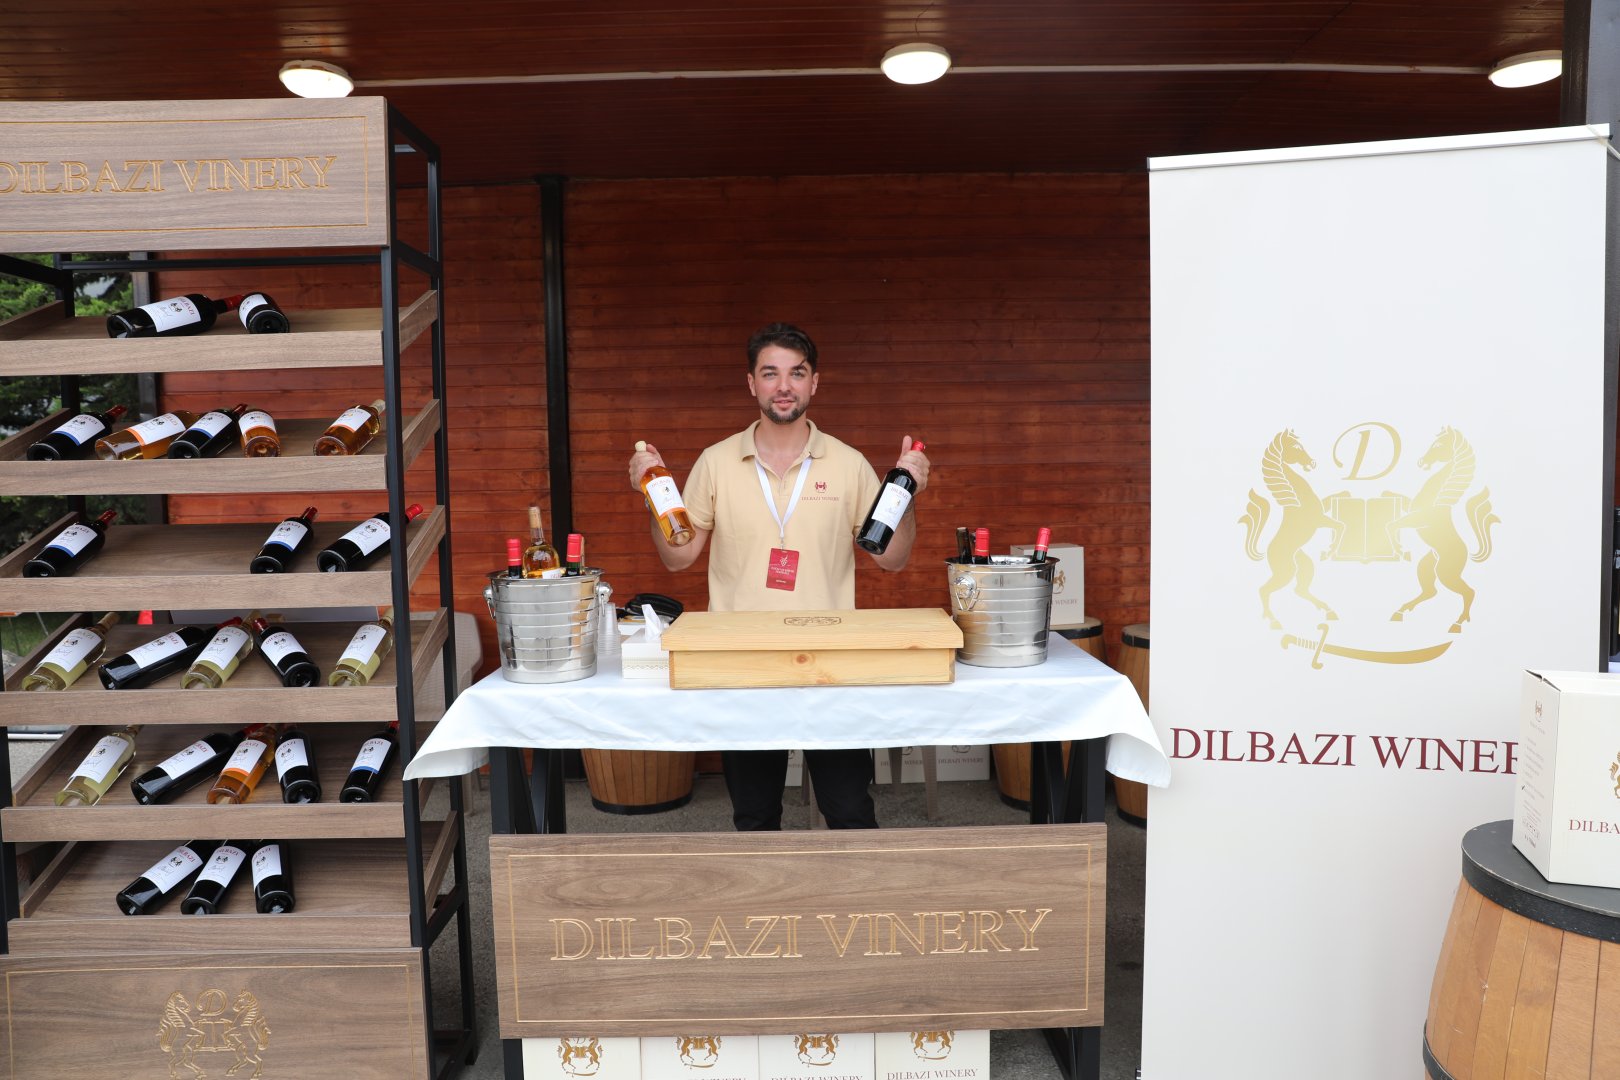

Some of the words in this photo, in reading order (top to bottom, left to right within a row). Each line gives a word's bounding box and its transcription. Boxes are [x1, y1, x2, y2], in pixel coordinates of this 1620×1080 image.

[173, 155, 337, 192] VINERY
[1169, 727, 1357, 766] DILBAZI
[1369, 735, 1519, 774] WINER
[1569, 819, 1620, 835] DILBA
[549, 915, 803, 960] DILBAZI
[816, 908, 1053, 957] VINERY
[887, 1071, 930, 1080] DILBAZI
[935, 1068, 978, 1078] WINERY
